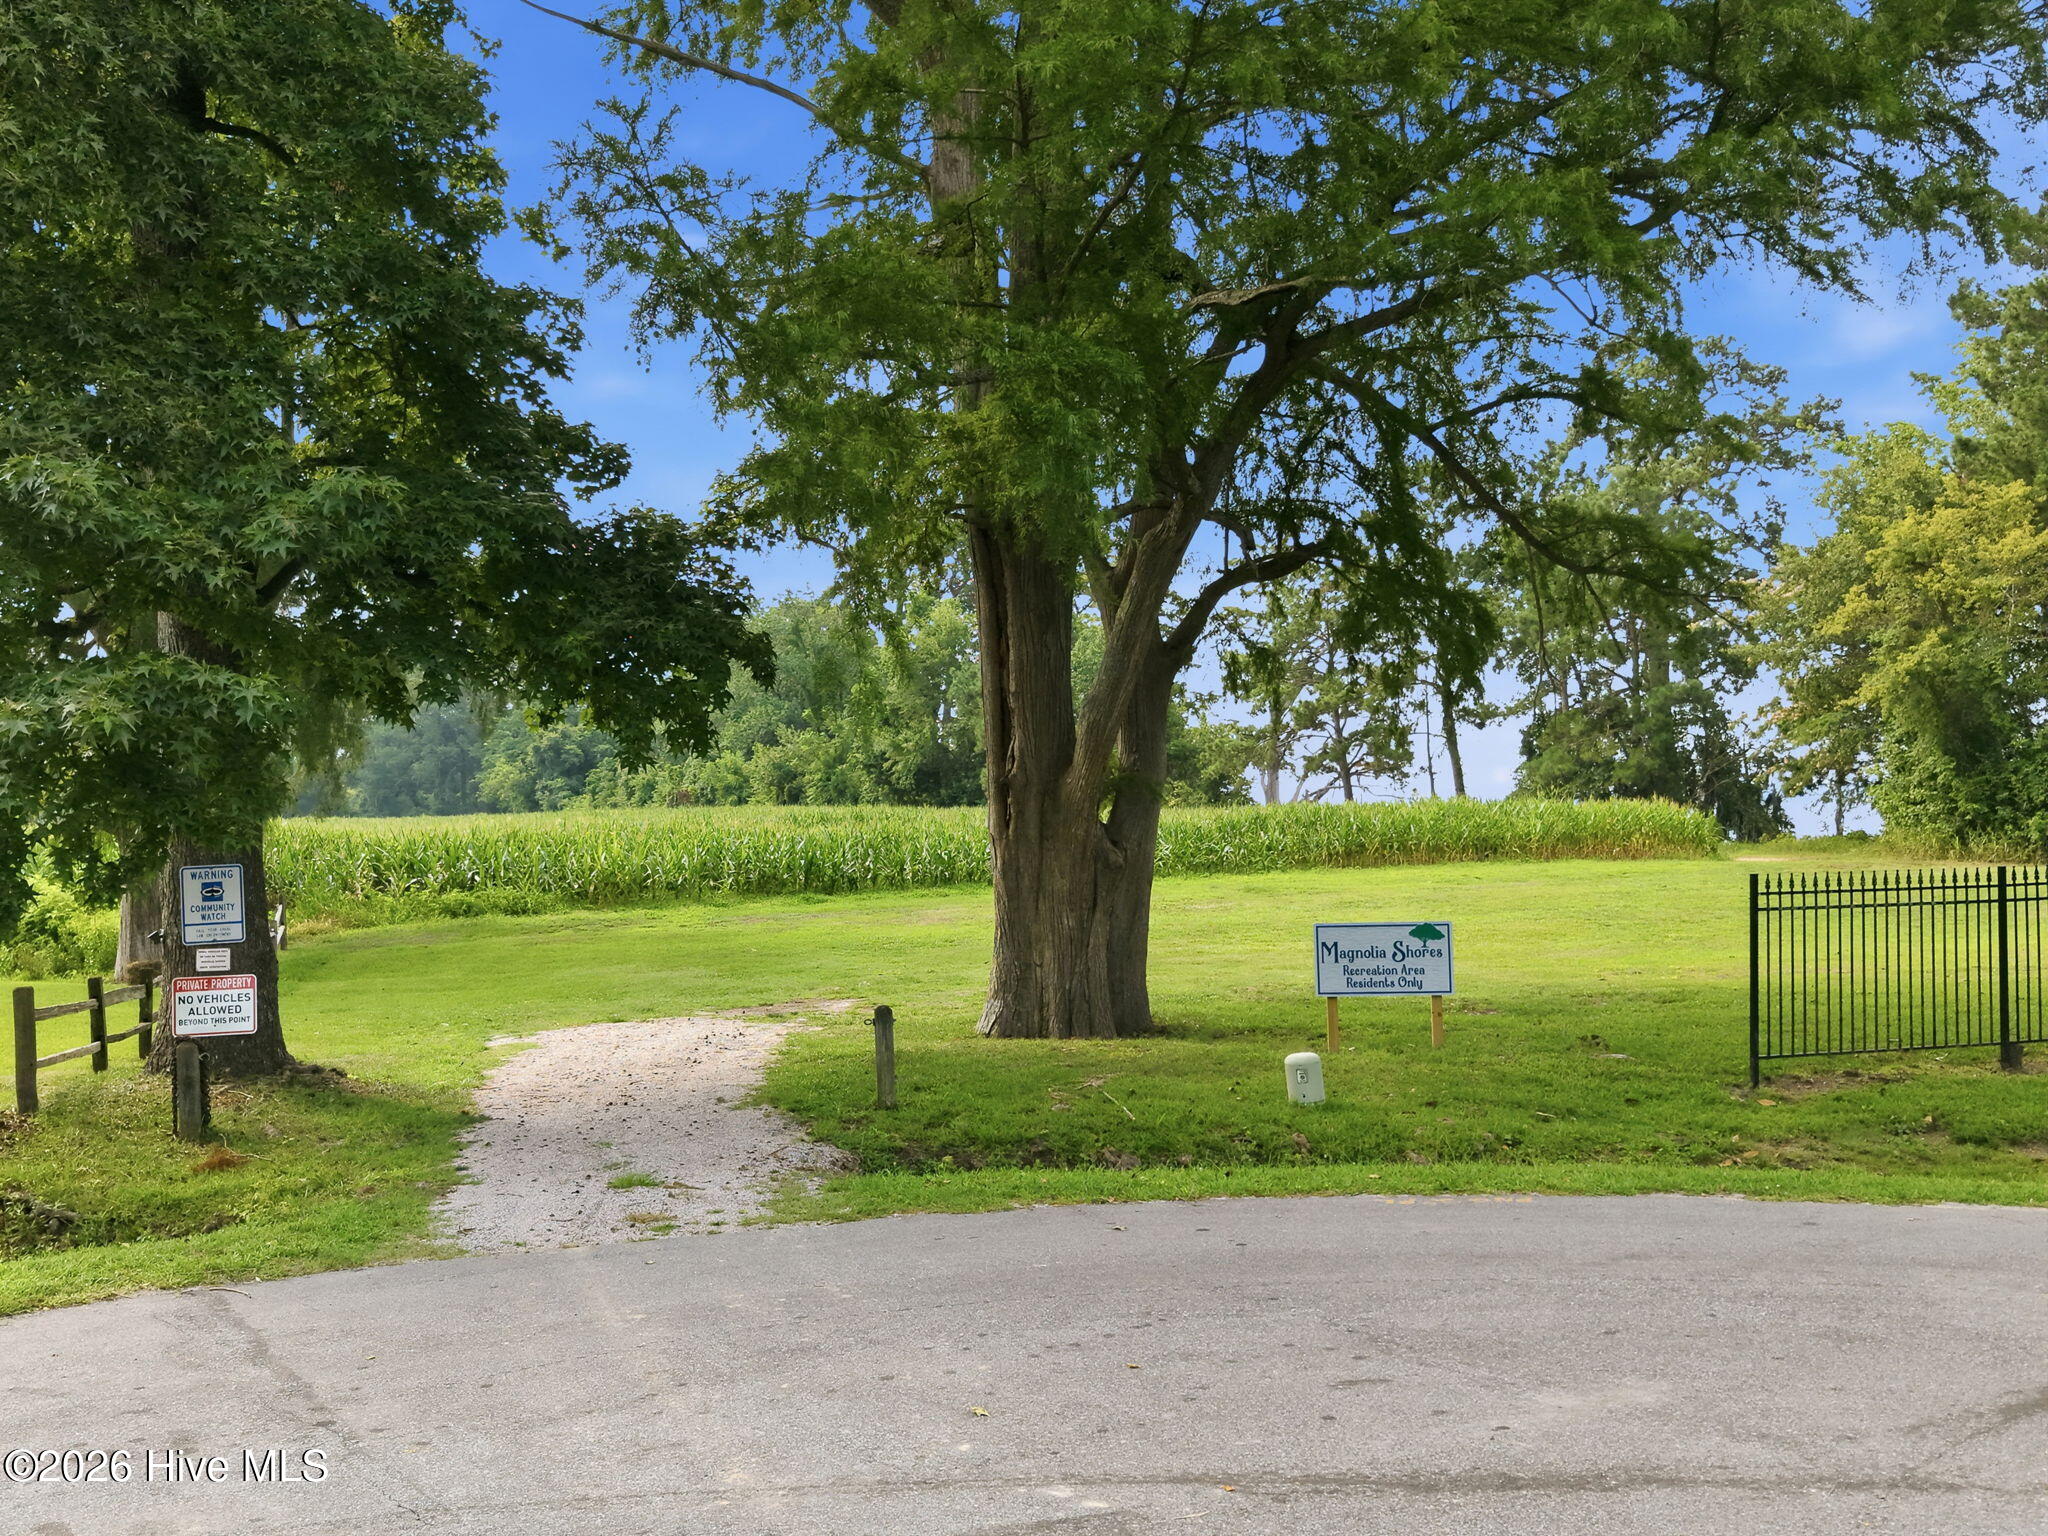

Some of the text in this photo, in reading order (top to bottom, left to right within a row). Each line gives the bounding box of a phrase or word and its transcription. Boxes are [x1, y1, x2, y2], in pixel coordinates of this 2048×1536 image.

[190, 869, 233, 880] WARNING
[190, 903, 235, 913] COMMUNITY
[200, 913, 226, 921] WATCH
[1321, 940, 1443, 964] Magnolia Shores
[1343, 963, 1425, 976] Recreation Area
[176, 977, 252, 990] PRIVATE PROPERTY
[1346, 976, 1423, 990] Residents Only
[178, 992, 251, 1005] NO VEHICLES
[188, 1004, 242, 1016] ALLOWED
[178, 1015, 251, 1027] BEYOND THIS POINT
